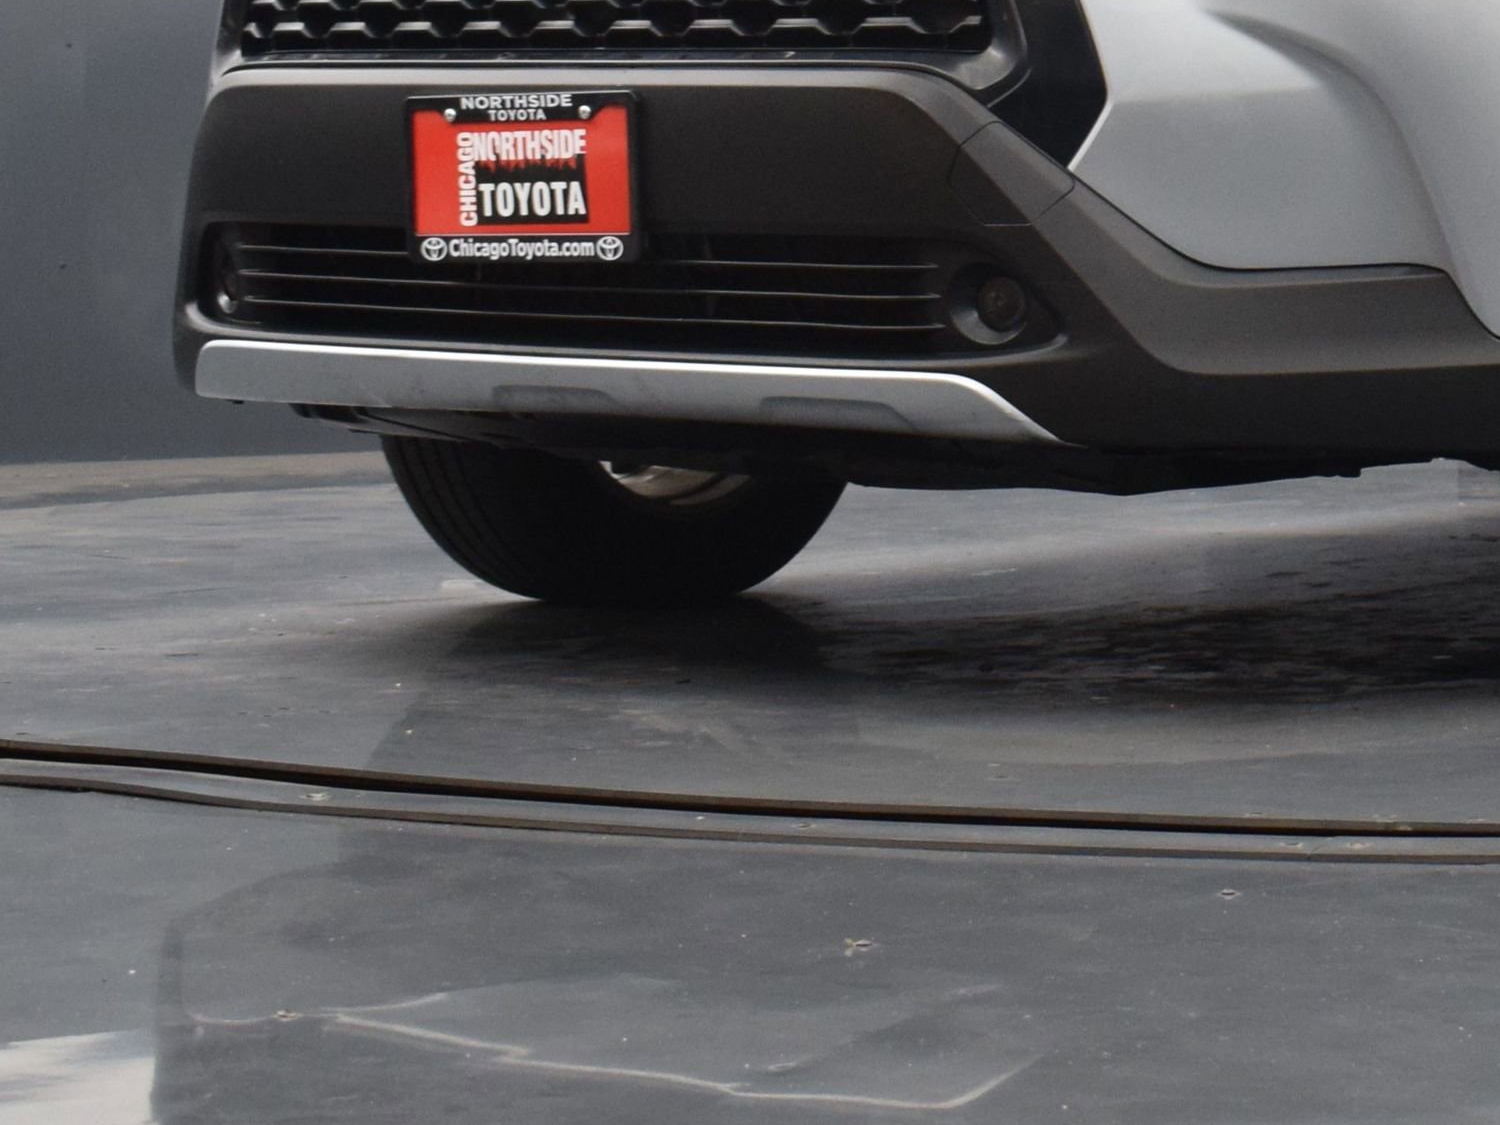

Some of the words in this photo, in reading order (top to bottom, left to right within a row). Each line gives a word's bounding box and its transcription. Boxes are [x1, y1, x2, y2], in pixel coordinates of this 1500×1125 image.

[460, 94, 573, 110] NORTHSIDE
[488, 109, 547, 121] TOYOTA
[474, 129, 587, 162] NORTHSIDE
[456, 132, 478, 227] CHICAGO
[479, 181, 587, 217] TOYOTA
[449, 238, 595, 261] ChicagoToyota.com
